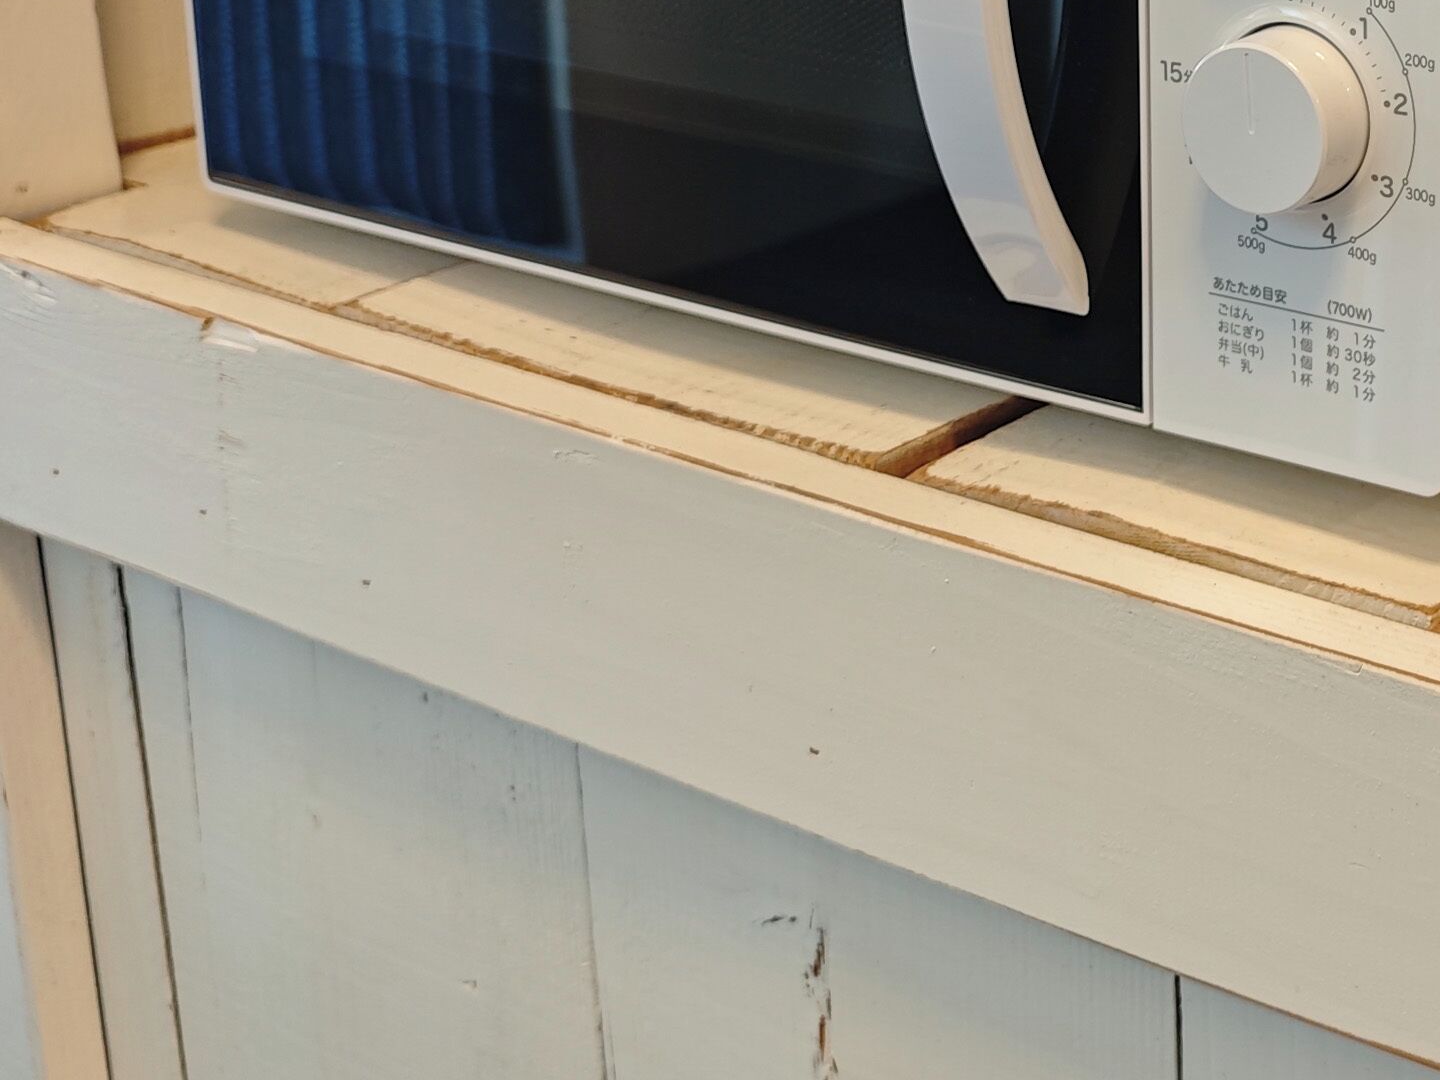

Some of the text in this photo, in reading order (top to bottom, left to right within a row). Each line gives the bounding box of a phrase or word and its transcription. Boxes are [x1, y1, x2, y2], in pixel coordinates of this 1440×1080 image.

[1359, 18, 1368, 39] 1
[1404, 53, 1436, 72] 200g
[1393, 93, 1408, 116] 2
[1379, 175, 1394, 198] 3
[1405, 186, 1436, 206] 300g
[1322, 222, 1337, 245] 4
[1237, 235, 1266, 254] 500g
[1348, 246, 1377, 266] 400g
[1213, 276, 1373, 323] あたため目安 (700W)
[1218, 303, 1253, 322] ごはん
[1218, 320, 1265, 342] おにぎり
[1218, 337, 1265, 360] 弁当(中)
